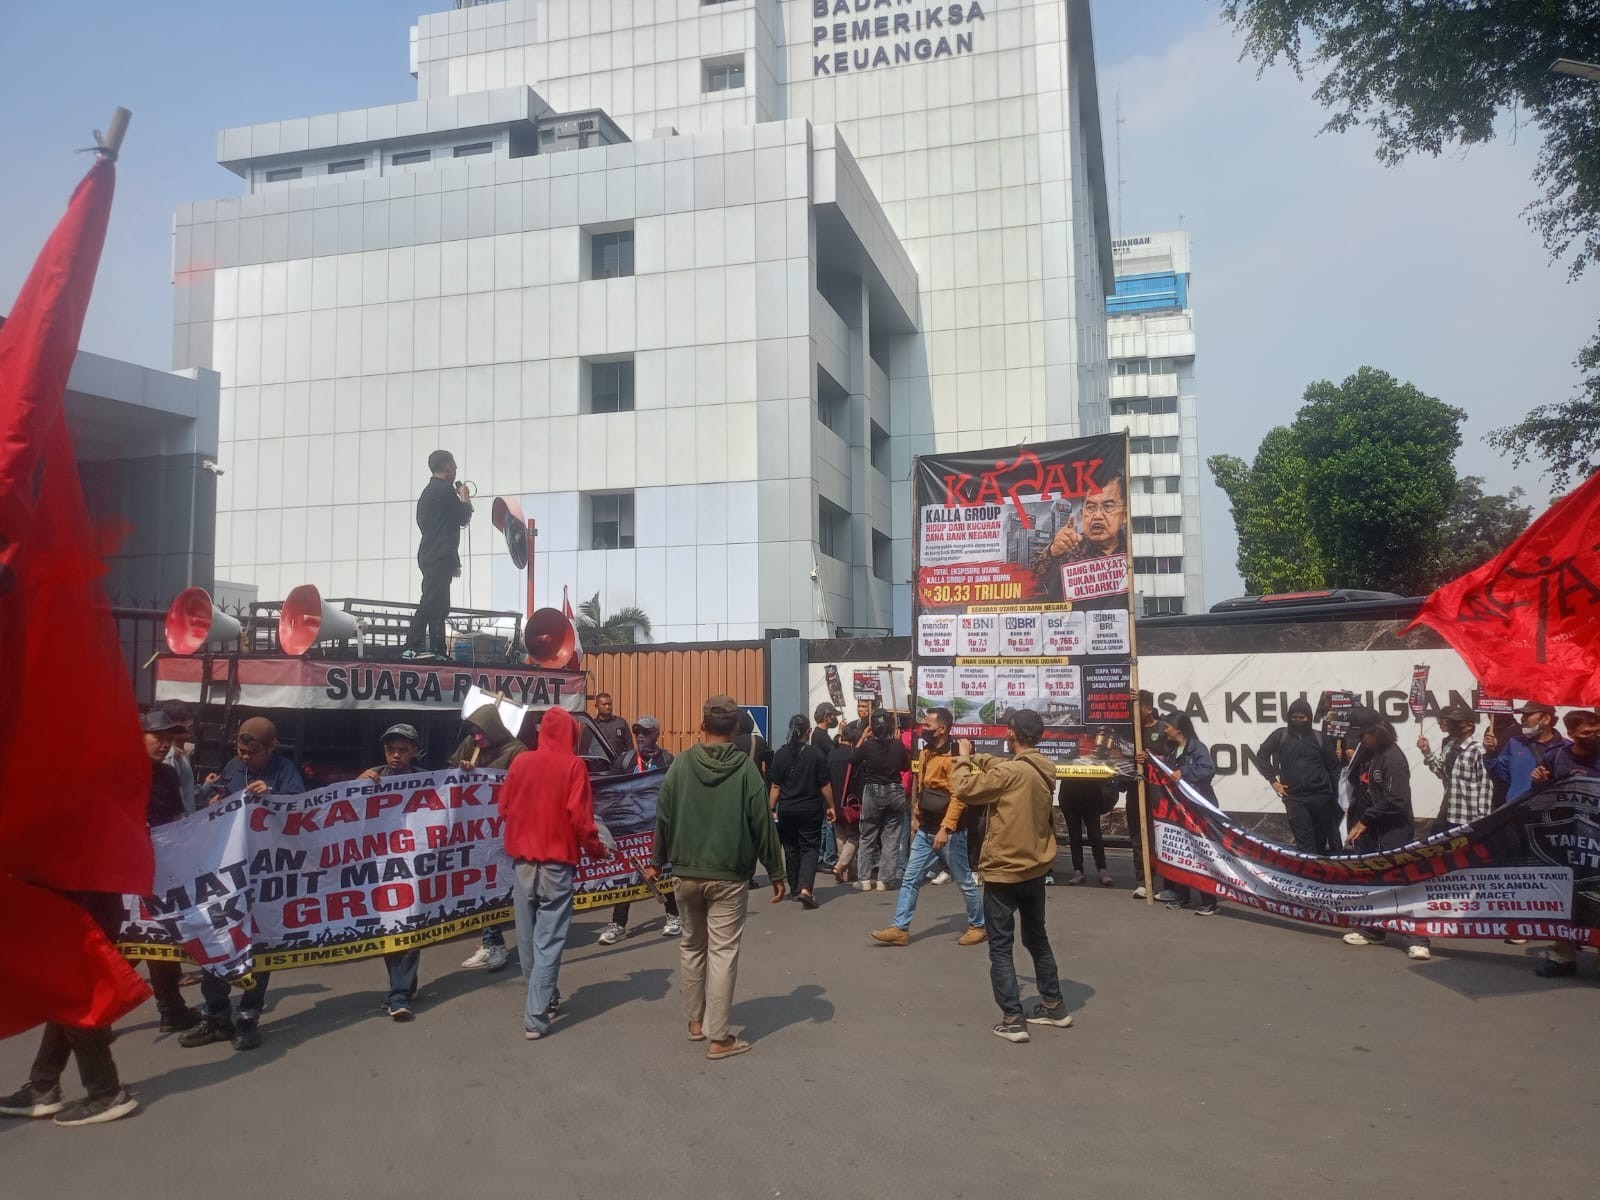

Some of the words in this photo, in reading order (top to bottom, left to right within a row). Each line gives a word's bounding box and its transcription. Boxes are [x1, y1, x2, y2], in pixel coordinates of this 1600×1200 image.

[813, 1, 985, 47] PEMERIKSA
[813, 32, 973, 76] KEUANGAN
[1112, 237, 1150, 248] EUANGAN
[925, 509, 961, 523] KALLA
[965, 506, 1001, 521] GROUP
[926, 524, 947, 532] HIDUP
[948, 522, 965, 531] DARI
[967, 520, 1001, 530] KUCURAN
[925, 533, 944, 542] DANA
[946, 531, 966, 541] BANK
[968, 530, 1000, 540] NEGARA!
[933, 568, 949, 576] TOTAL
[981, 566, 1000, 574] UTANG
[1066, 564, 1088, 577] UANG
[1089, 558, 1123, 573] RAKYAT
[926, 576, 945, 584] KALLA
[946, 575, 966, 583] GROUP
[967, 575, 974, 583] DI
[975, 574, 991, 583] BANK
[1068, 573, 1096, 587] BUKAN
[1097, 569, 1125, 581] UNTUK
[923, 588, 932, 598] Rp
[933, 585, 971, 603] 30,33
[974, 583, 1022, 601] TRILIUN
[973, 618, 993, 630] BNI
[1017, 617, 1036, 629] BRI
[1047, 619, 1062, 628] BSI
[924, 639, 933, 647] Rp
[968, 639, 977, 647] Rp
[978, 639, 988, 647] 7,1
[1007, 638, 1017, 647] Rp
[1049, 637, 1058, 646] Rp
[326, 667, 442, 702] SUARA
[453, 673, 566, 705] RAKYAT
[961, 681, 970, 689] Rp
[971, 681, 987, 689] 3,44
[1007, 681, 1016, 690] Rp
[1018, 681, 1025, 689] 11
[949, 726, 982, 736] ENUNTUT
[208, 795, 299, 821] KOMITE
[304, 789, 338, 809] AKSI
[346, 777, 436, 797] PEMUDA
[1164, 826, 1183, 837] BPK
[319, 829, 416, 868] UANG
[426, 815, 506, 850] RAKY
[620, 835, 652, 848] TANG
[1163, 833, 1189, 845] AUDIT
[1162, 840, 1191, 852] KALLA
[622, 846, 653, 860] TRIL
[1162, 846, 1196, 860] SENILAI
[1162, 852, 1174, 862] Rp
[341, 844, 475, 888] MACET
[586, 862, 625, 878] BANK
[1271, 875, 1293, 885] KPK
[1424, 874, 1467, 883] NEGARA
[1469, 873, 1501, 882] TIDAK
[1504, 872, 1537, 881] BOLEH
[1538, 872, 1571, 882] TAKUT,
[1425, 882, 1487, 892] BONGKAR
[1489, 881, 1550, 890] SKANDAL
[283, 864, 498, 929] GROUP!
[1427, 891, 1471, 901] KREDIT
[1475, 891, 1517, 900] MACET
[1215, 882, 1262, 909] UANG
[1265, 901, 1340, 924] RAKYAT
[1350, 915, 1416, 933] BUKAN
[1426, 921, 1509, 937] UNTUK
[1427, 901, 1481, 913] 30,33
[1485, 900, 1564, 912] TRILIUN!
[265, 939, 386, 966] ISTIMEWA!
[394, 924, 456, 946] HUKUM
[459, 909, 511, 928] HARUS
[592, 888, 641, 902] UNTUK
